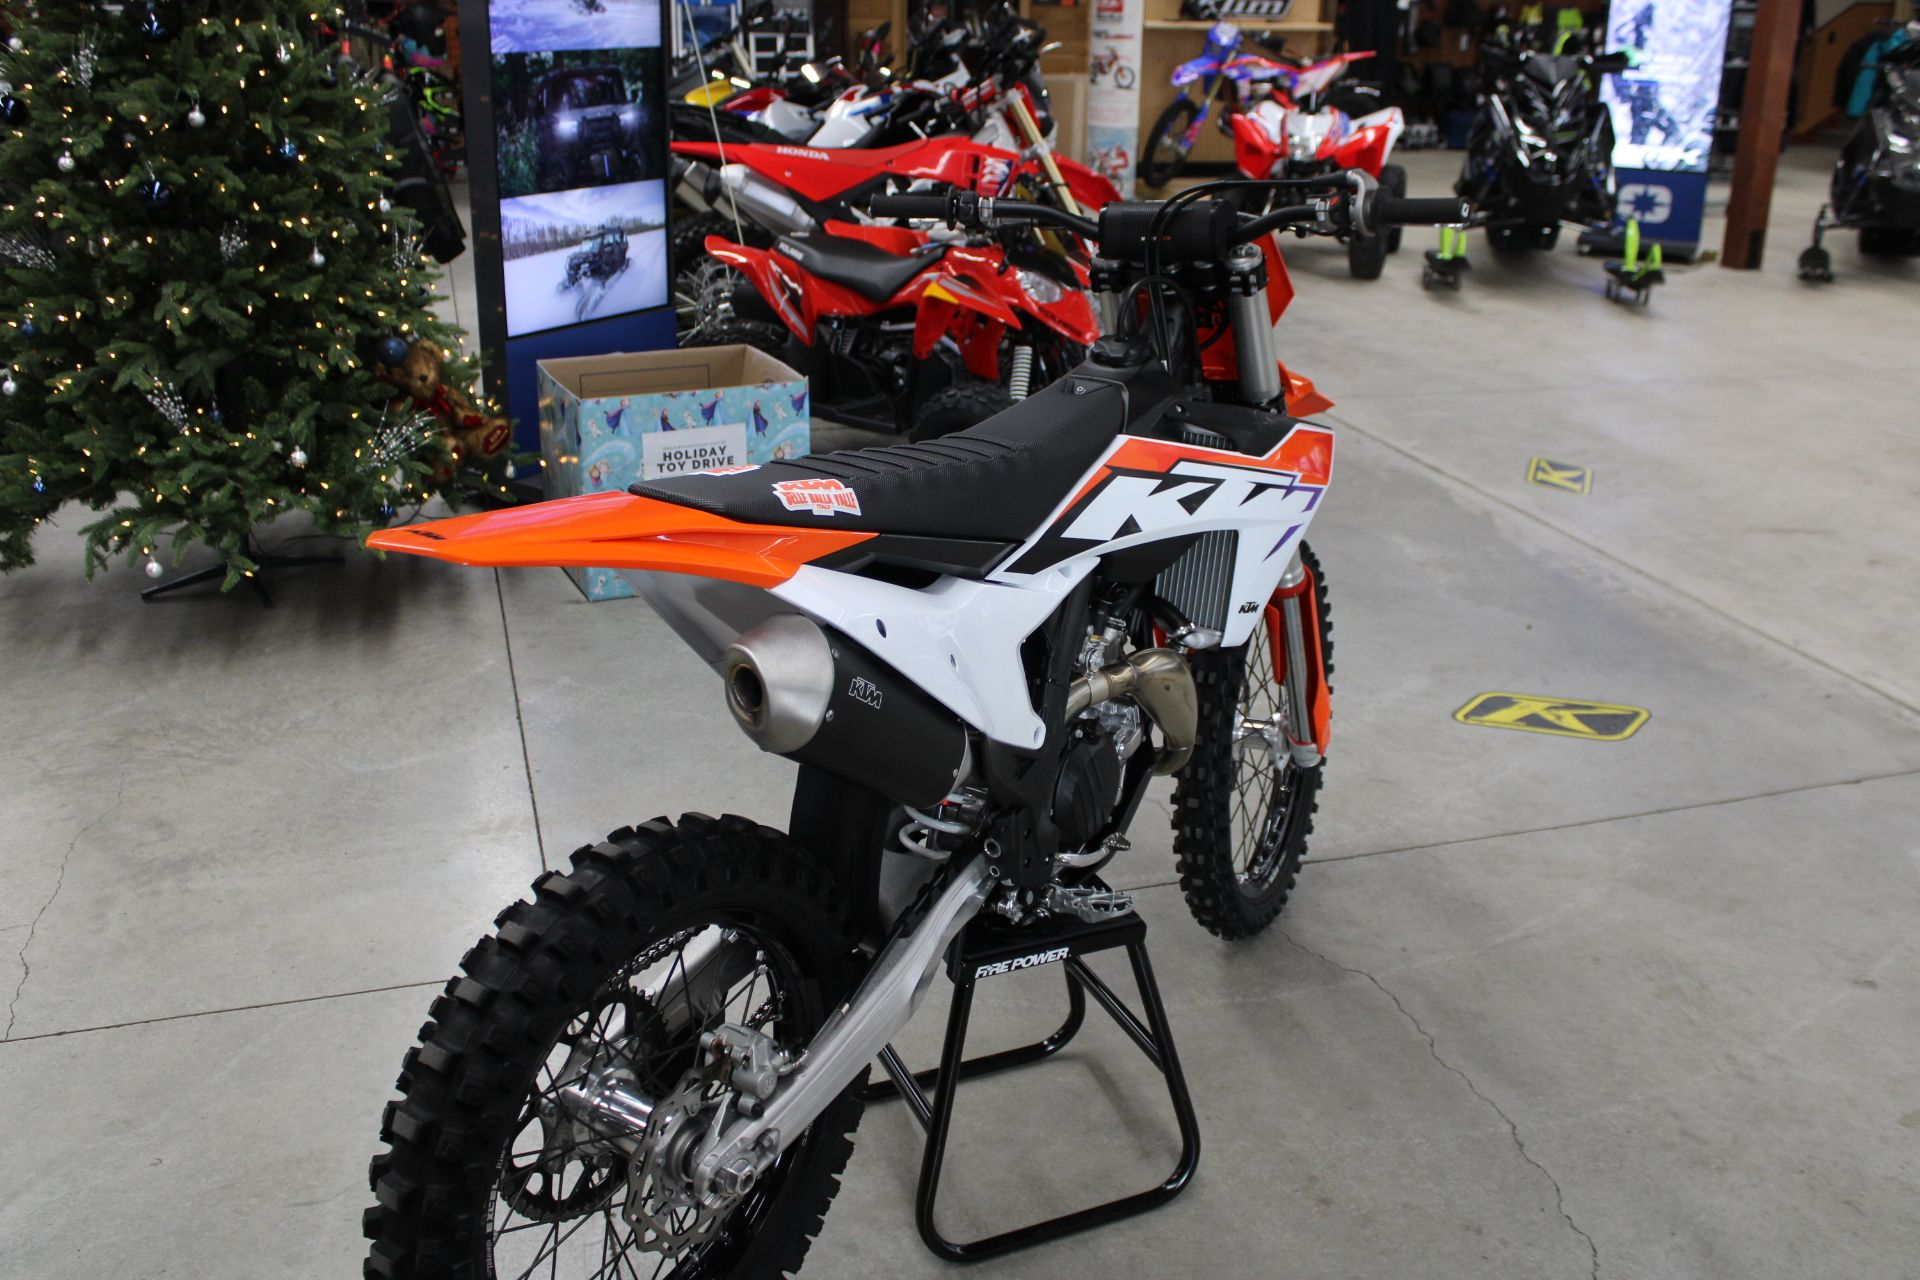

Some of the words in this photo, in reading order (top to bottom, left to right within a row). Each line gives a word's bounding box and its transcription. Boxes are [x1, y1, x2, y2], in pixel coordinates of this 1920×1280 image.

[776, 145, 831, 162] HONDA
[656, 461, 686, 473] TOY
[692, 455, 735, 470] DRIVE
[662, 445, 727, 462] HOLIDAY
[1060, 460, 1324, 556] KTM
[1238, 601, 1260, 614] KTM
[848, 676, 882, 709] KTM
[1010, 947, 1069, 971] POWER
[485, 1178, 500, 1233] EXCEL
